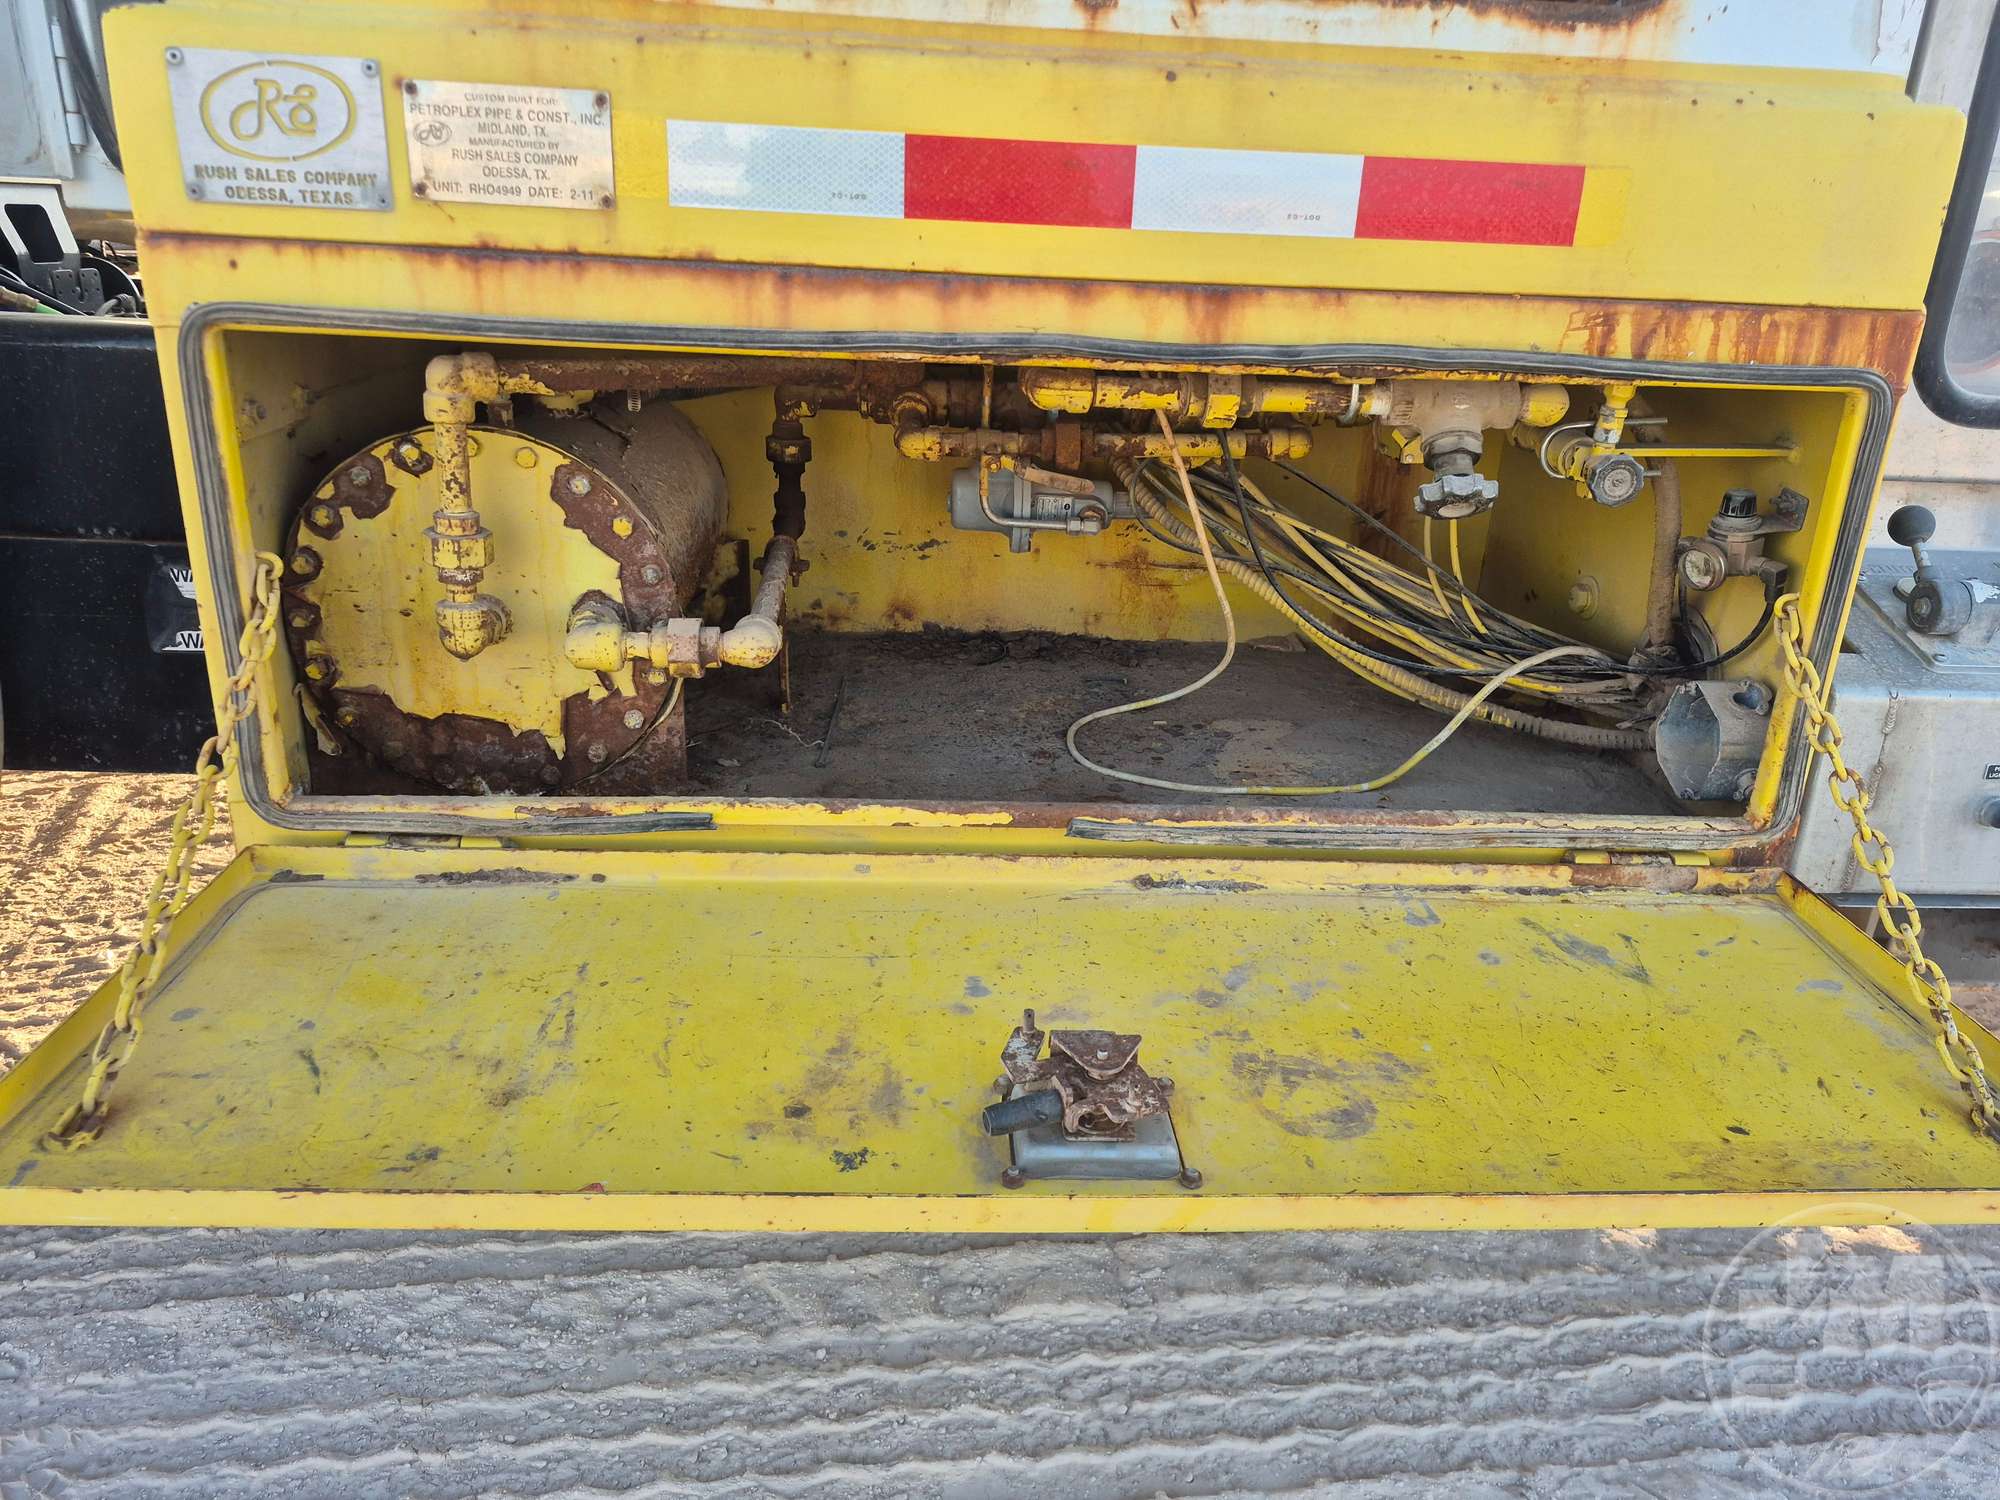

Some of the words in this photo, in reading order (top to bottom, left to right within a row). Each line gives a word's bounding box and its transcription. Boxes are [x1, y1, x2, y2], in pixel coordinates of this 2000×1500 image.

[464, 92, 505, 103] CUSTOM
[508, 95, 533, 104] BUILT
[410, 103, 481, 118] PETROPLEX
[485, 107, 512, 120] PIPE
[516, 108, 524, 120] &
[528, 110, 577, 125] CONST.,
[580, 113, 606, 126] INC.
[477, 122, 530, 137] MIDLAND,
[534, 125, 549, 137] TX.
[469, 137, 545, 149] MANUFACTURED
[550, 142, 560, 151] BY
[451, 148, 484, 161] RUSH
[486, 150, 521, 163] SALES
[524, 153, 578, 167] COMPANY
[194, 164, 238, 181] RUSH
[244, 167, 297, 184] SALES
[303, 171, 378, 187] COMPANY
[482, 165, 532, 180] ODESSA,
[535, 169, 551, 181] TX.
[225, 186, 294, 204] ODESSA,
[299, 189, 353, 204] TEXAS
[432, 181, 464, 195] UNIT:
[528, 186, 563, 199] DATE:
[570, 189, 594, 200] 2-11
